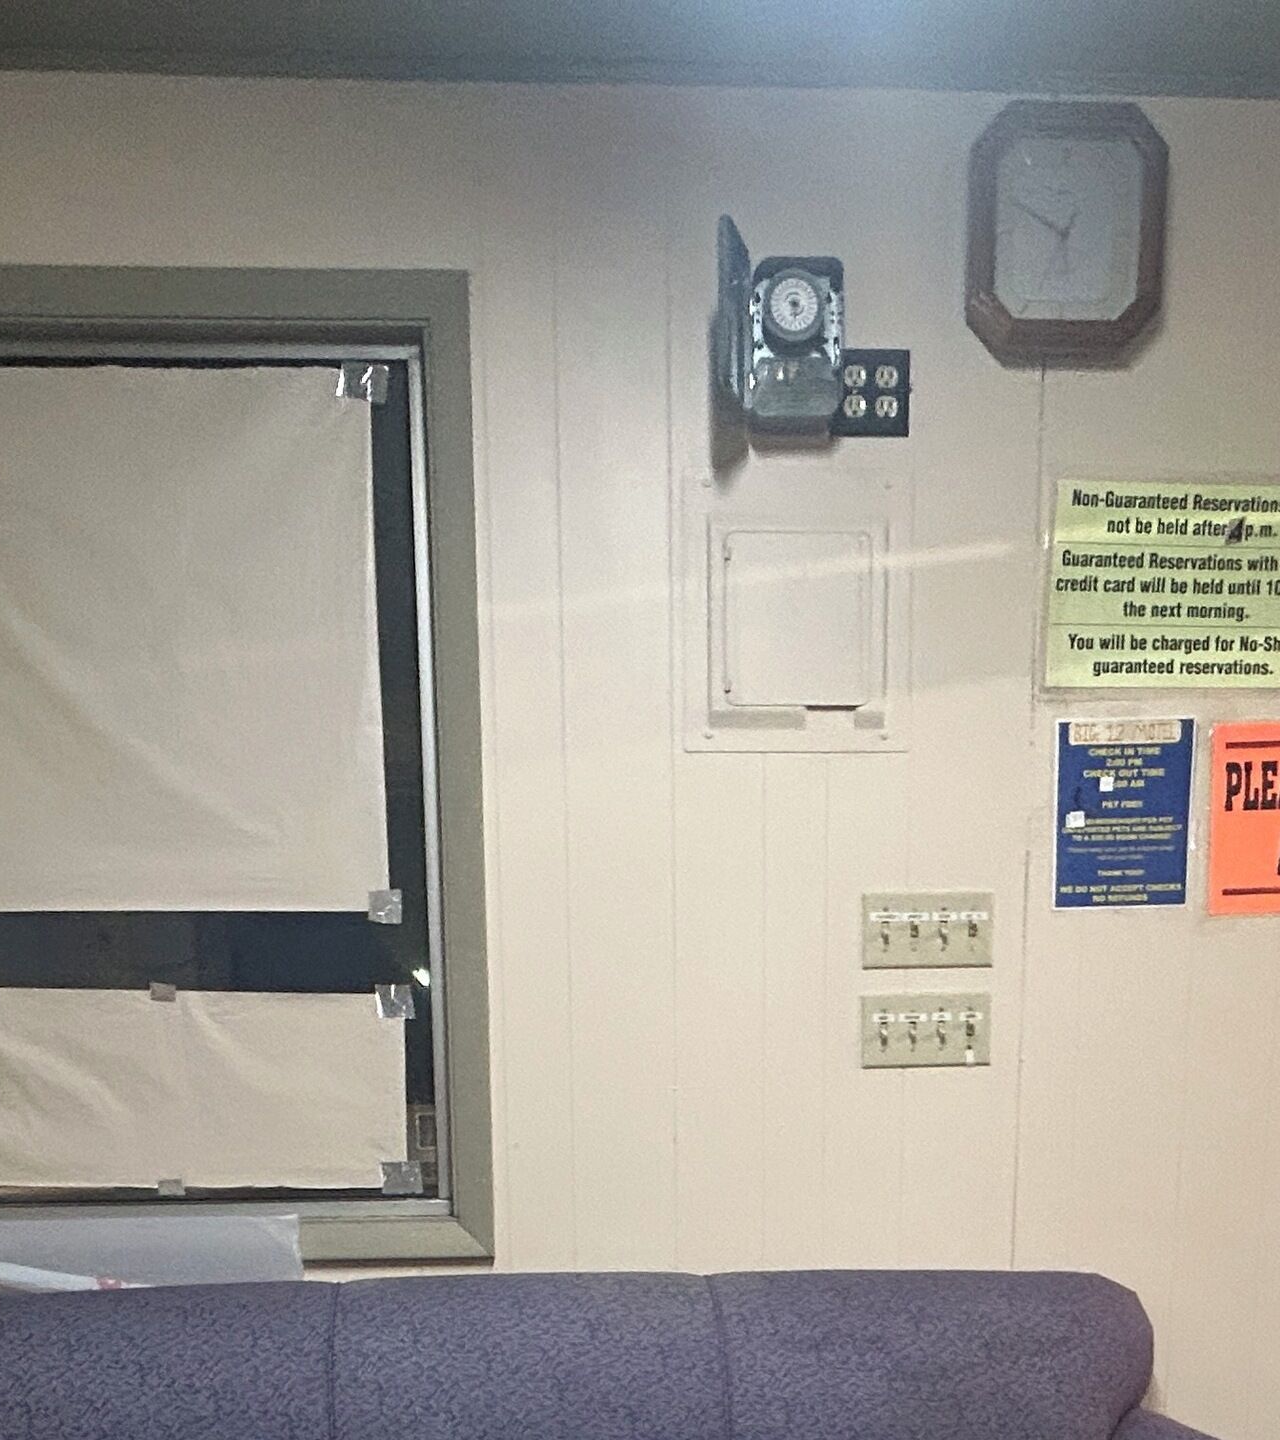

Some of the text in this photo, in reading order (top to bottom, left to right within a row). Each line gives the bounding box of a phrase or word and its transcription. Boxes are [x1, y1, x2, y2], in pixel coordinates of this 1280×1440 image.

[1072, 488, 1188, 511] Non-Guaranteed
[1107, 518, 1130, 534] not
[1135, 518, 1152, 535] be
[1157, 518, 1188, 536] held
[1192, 520, 1228, 537] after
[1245, 523, 1278, 541] p.m.
[1062, 550, 1144, 569] Guaranteed
[1149, 553, 1242, 571] Reservations
[1247, 555, 1278, 572] with
[1055, 576, 1098, 593] credit
[1103, 576, 1135, 593] card
[1140, 577, 1165, 594] will
[1170, 578, 1188, 594] be
[1192, 578, 1223, 595] held
[1228, 579, 1261, 595] until
[1123, 601, 1250, 621] the next morning.
[1068, 633, 1094, 650] You
[1099, 634, 1125, 650] will
[1130, 634, 1147, 651] be
[1152, 635, 1210, 654] charged
[1215, 635, 1235, 652] for
[1093, 659, 1274, 677] guaranteed reservations.
[1088, 748, 1121, 757] CHECK
[1083, 769, 1116, 778] CHECK
[1118, 768, 1139, 777] OUT
